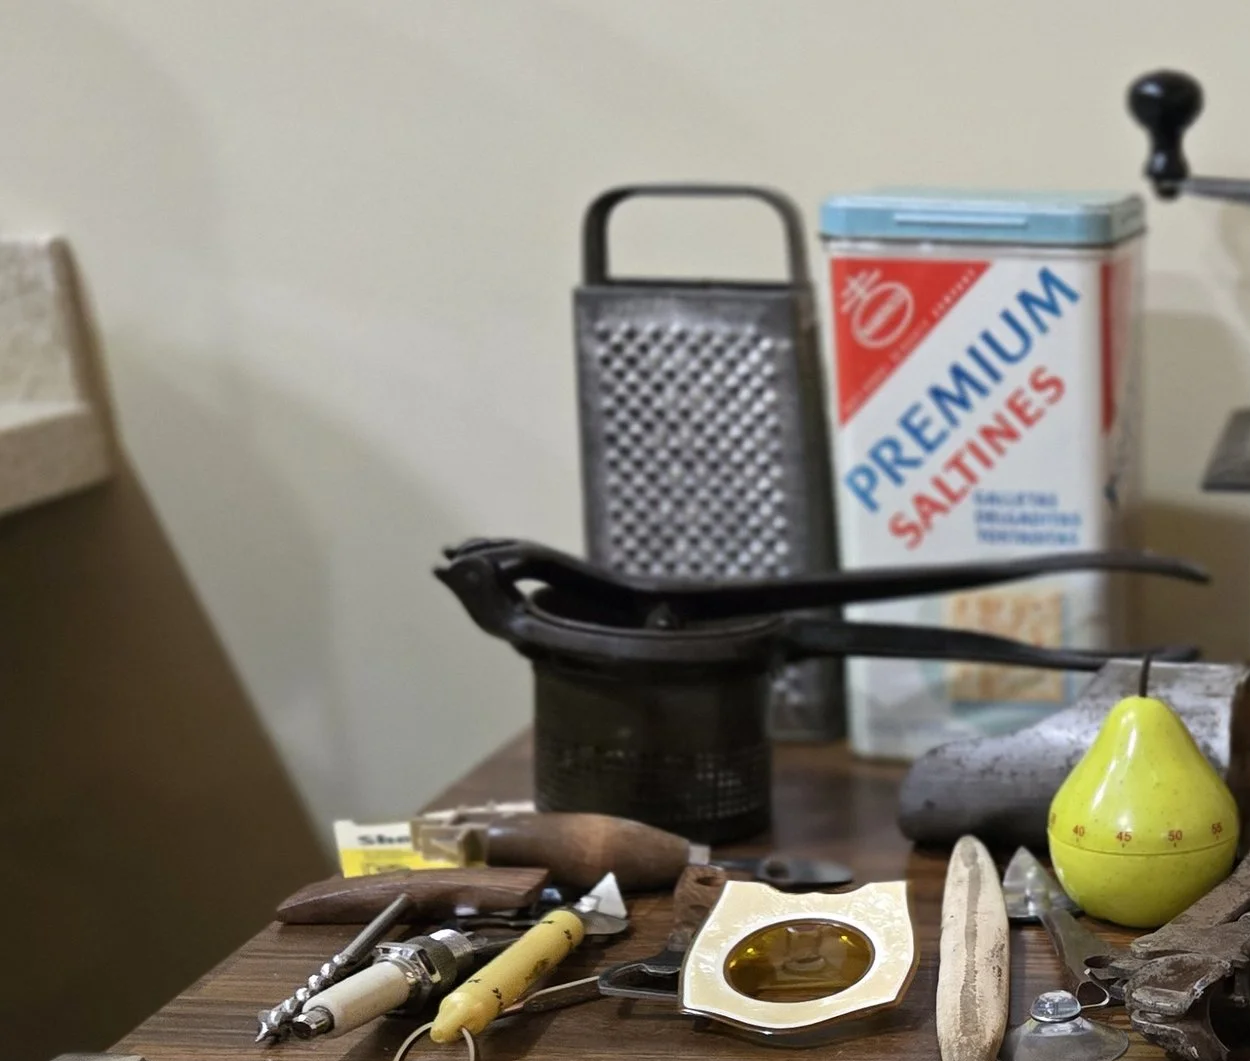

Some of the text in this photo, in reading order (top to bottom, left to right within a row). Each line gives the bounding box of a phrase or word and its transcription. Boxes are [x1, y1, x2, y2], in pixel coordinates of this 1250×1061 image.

[845, 267, 1080, 513] PREMIUM
[888, 366, 1066, 550] SALTINES
[1072, 822, 1223, 842] 40 45 50 55
